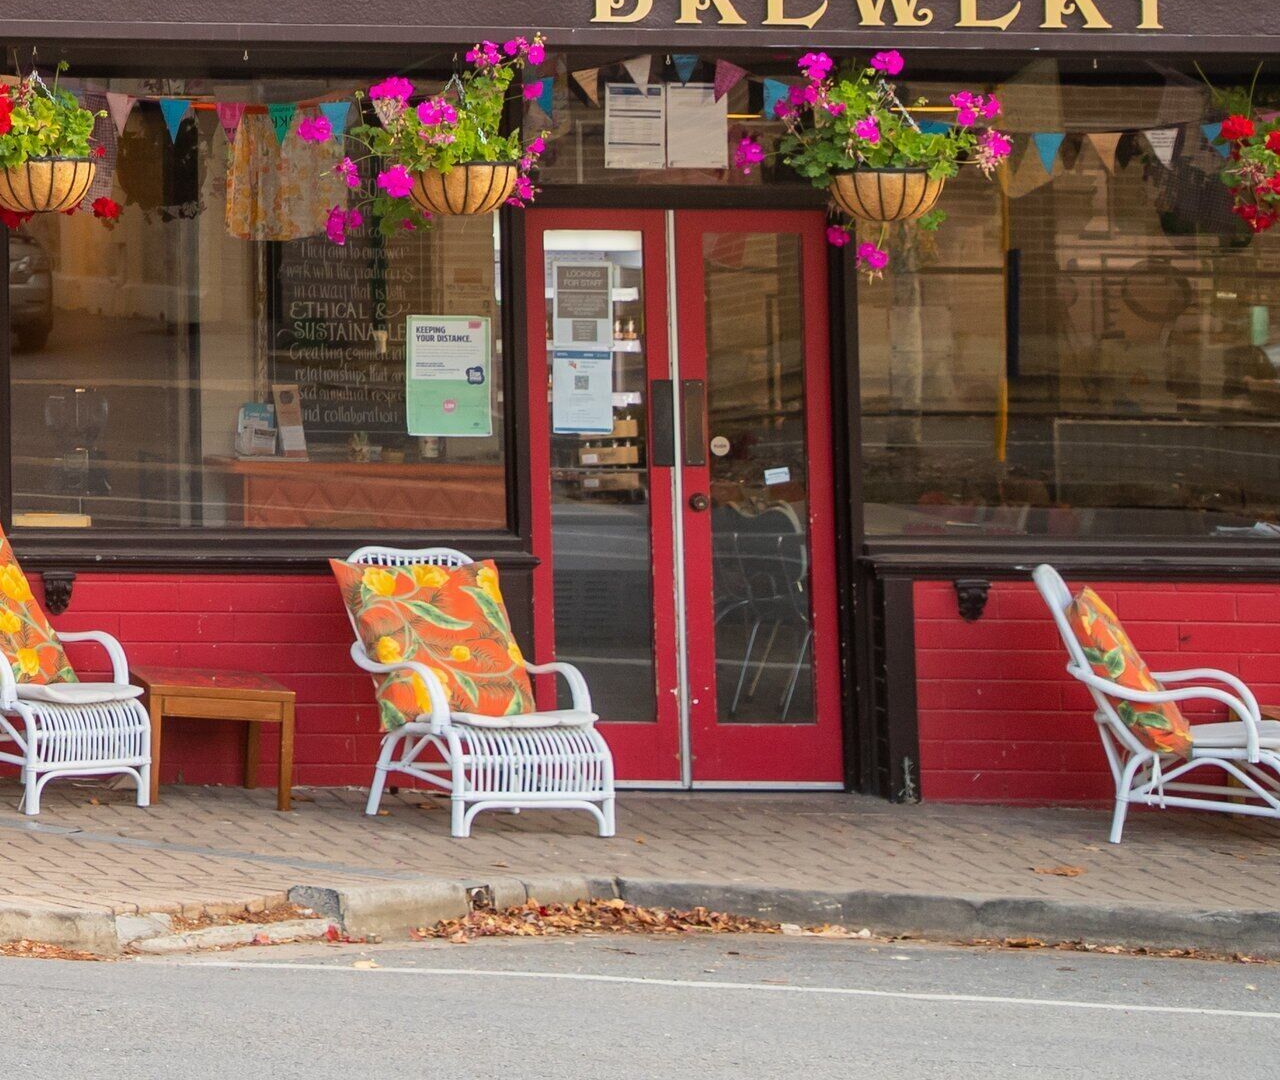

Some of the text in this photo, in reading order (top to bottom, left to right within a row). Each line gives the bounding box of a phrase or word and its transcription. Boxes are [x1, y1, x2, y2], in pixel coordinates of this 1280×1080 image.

[289, 301, 369, 319] ETHICAL
[416, 326, 446, 334] KEEPING
[416, 334, 472, 343] YOUR DISTANCE.
